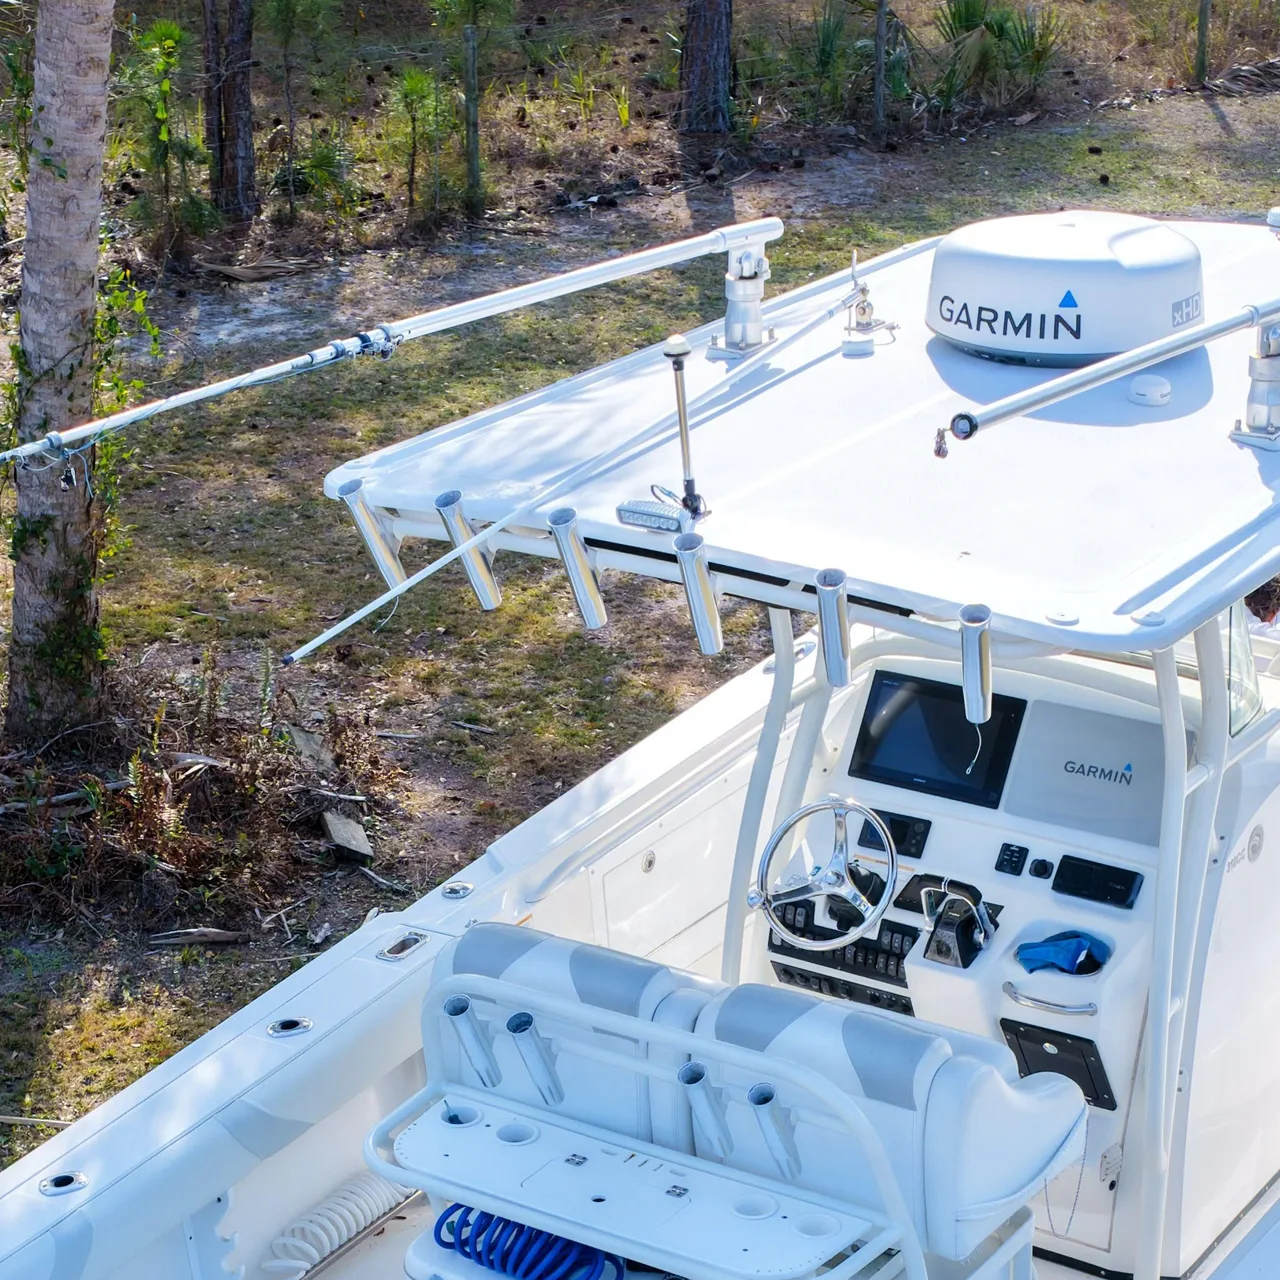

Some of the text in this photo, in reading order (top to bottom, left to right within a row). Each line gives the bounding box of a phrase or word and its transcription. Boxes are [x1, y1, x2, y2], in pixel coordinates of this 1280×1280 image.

[939, 295, 1082, 340] GARMIN
[1173, 294, 1201, 326] xHD
[1063, 760, 1133, 787] GARMIN
